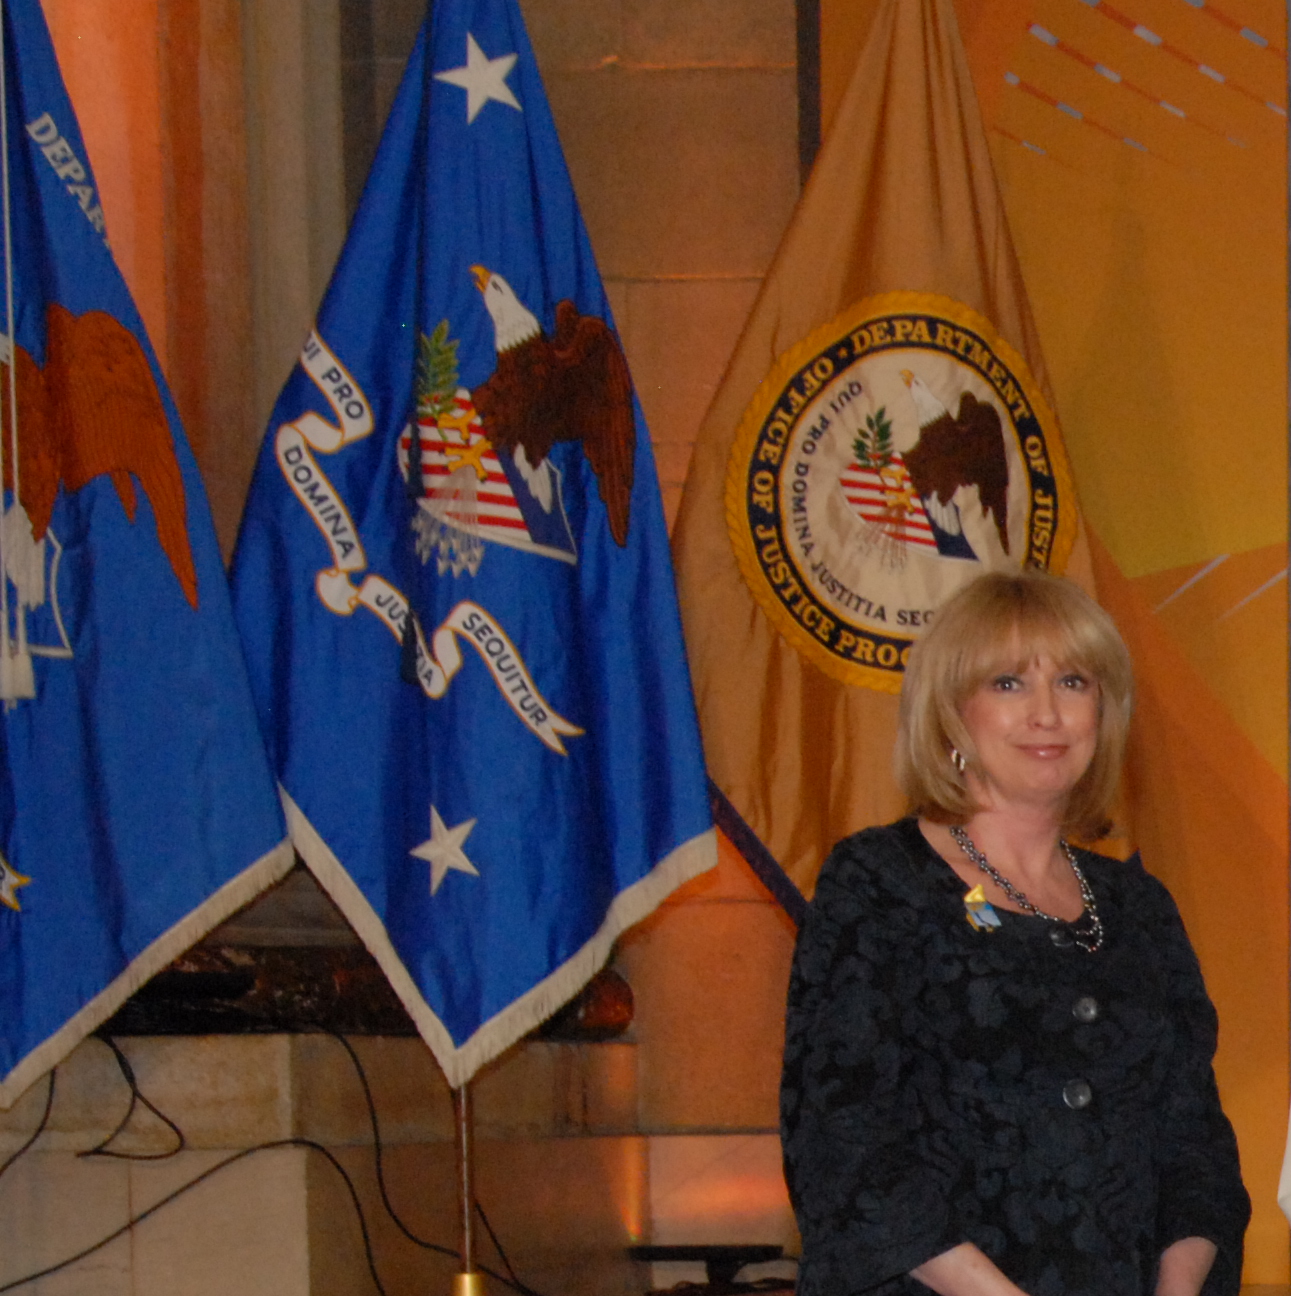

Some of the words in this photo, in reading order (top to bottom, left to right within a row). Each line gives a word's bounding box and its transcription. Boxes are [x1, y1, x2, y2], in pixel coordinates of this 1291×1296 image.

[321, 366, 365, 420] PRO
[757, 355, 835, 466] OFFICE
[801, 413, 832, 455] PRO
[829, 380, 863, 414] QUI
[851, 319, 1031, 422] DEPARTMENT
[1024, 434, 1049, 478] OF
[283, 445, 356, 559] DOMINA
[752, 469, 775, 514] OF
[792, 461, 815, 557] DOMINA
[755, 523, 836, 643] JUSTICE
[810, 560, 888, 622] JUSTITIA
[462, 612, 548, 726] SEQUITUR
